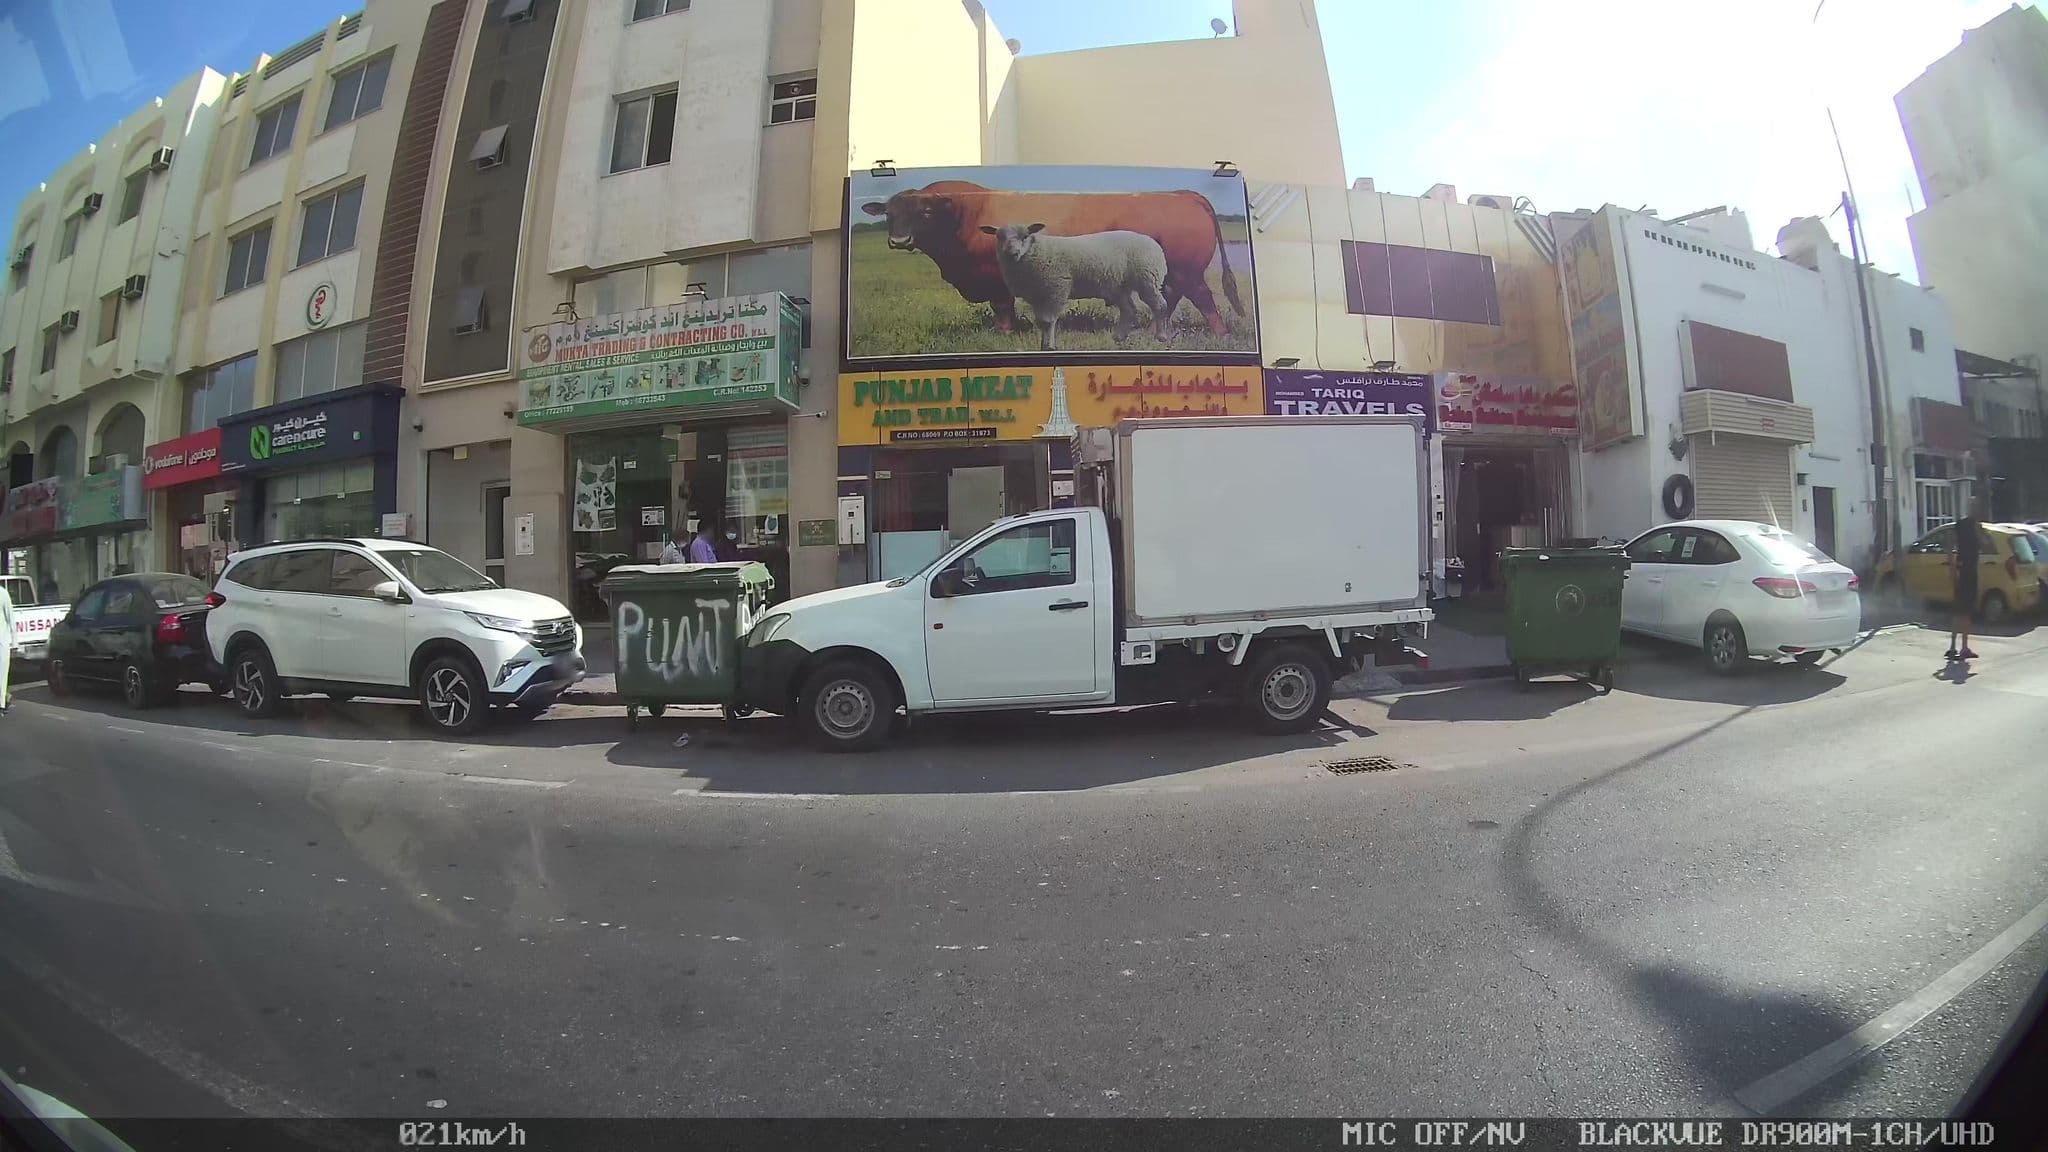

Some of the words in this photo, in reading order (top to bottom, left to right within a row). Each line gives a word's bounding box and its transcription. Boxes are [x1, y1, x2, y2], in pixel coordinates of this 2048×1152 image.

[592, 337, 637, 357] TRADING
[650, 325, 727, 349] CONTRACTING
[730, 323, 748, 339] CO.
[585, 356, 605, 369] SALES
[611, 352, 640, 365] SERVICE
[854, 377, 953, 408] PUNJAB
[959, 375, 1033, 402] MEAT
[1311, 388, 1365, 400] TARIQ
[872, 408, 912, 427] AND
[154, 454, 184, 471] vodafone
